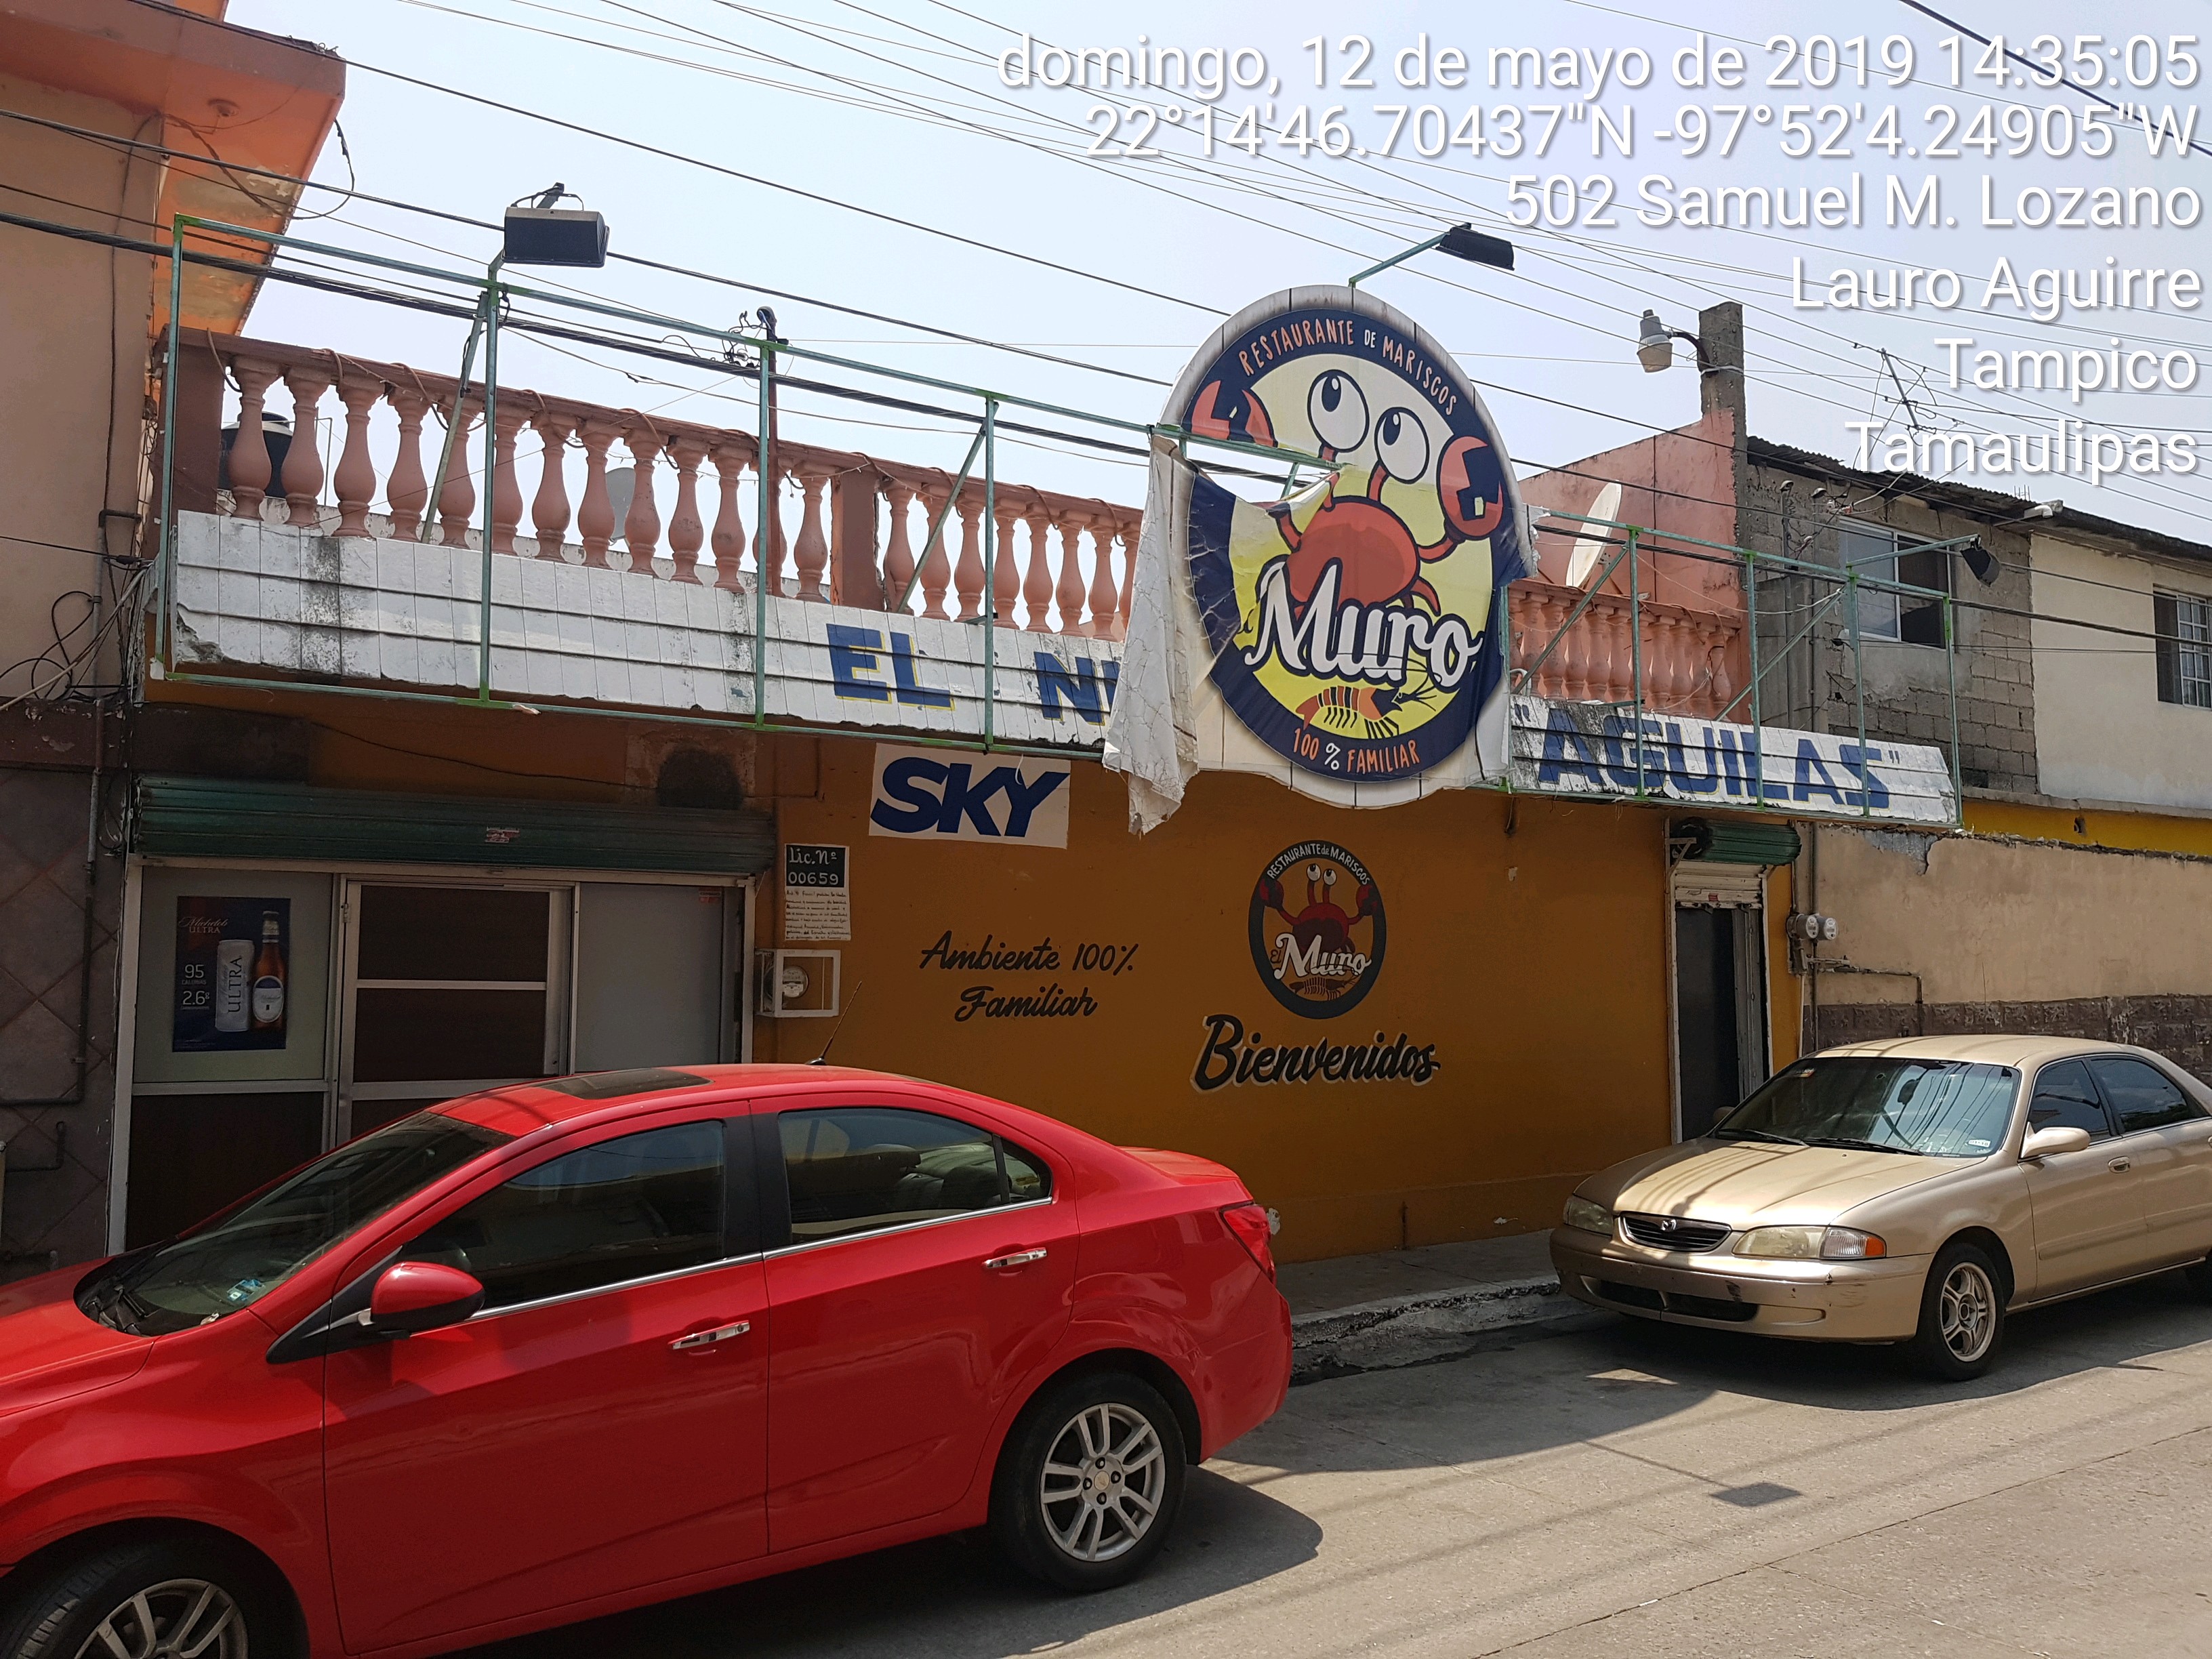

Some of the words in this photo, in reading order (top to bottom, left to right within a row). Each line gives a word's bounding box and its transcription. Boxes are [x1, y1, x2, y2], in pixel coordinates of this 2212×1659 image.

[1238, 319, 1355, 377] RESTAURANTE
[1365, 329, 1376, 348] DE
[1382, 335, 1457, 416] MARISCOS
[1244, 558, 1484, 687] Muro
[825, 623, 955, 712] EL
[1293, 727, 1319, 760] 100
[1324, 742, 1341, 771] %
[1347, 739, 1420, 775] FAMILIAR
[871, 756, 1071, 838] SKY
[787, 872, 839, 885] 00659
[1266, 843, 1322, 880] RESTAURANTE
[1330, 846, 1370, 886] MARISCOS
[184, 964, 205, 979] 95
[919, 931, 1060, 971] Ambiente
[1273, 931, 1373, 981] Muro
[228, 954, 243, 1014] ULTRA
[954, 983, 1098, 1022] Familiar
[1191, 1014, 1441, 1092] Bienvenidos
